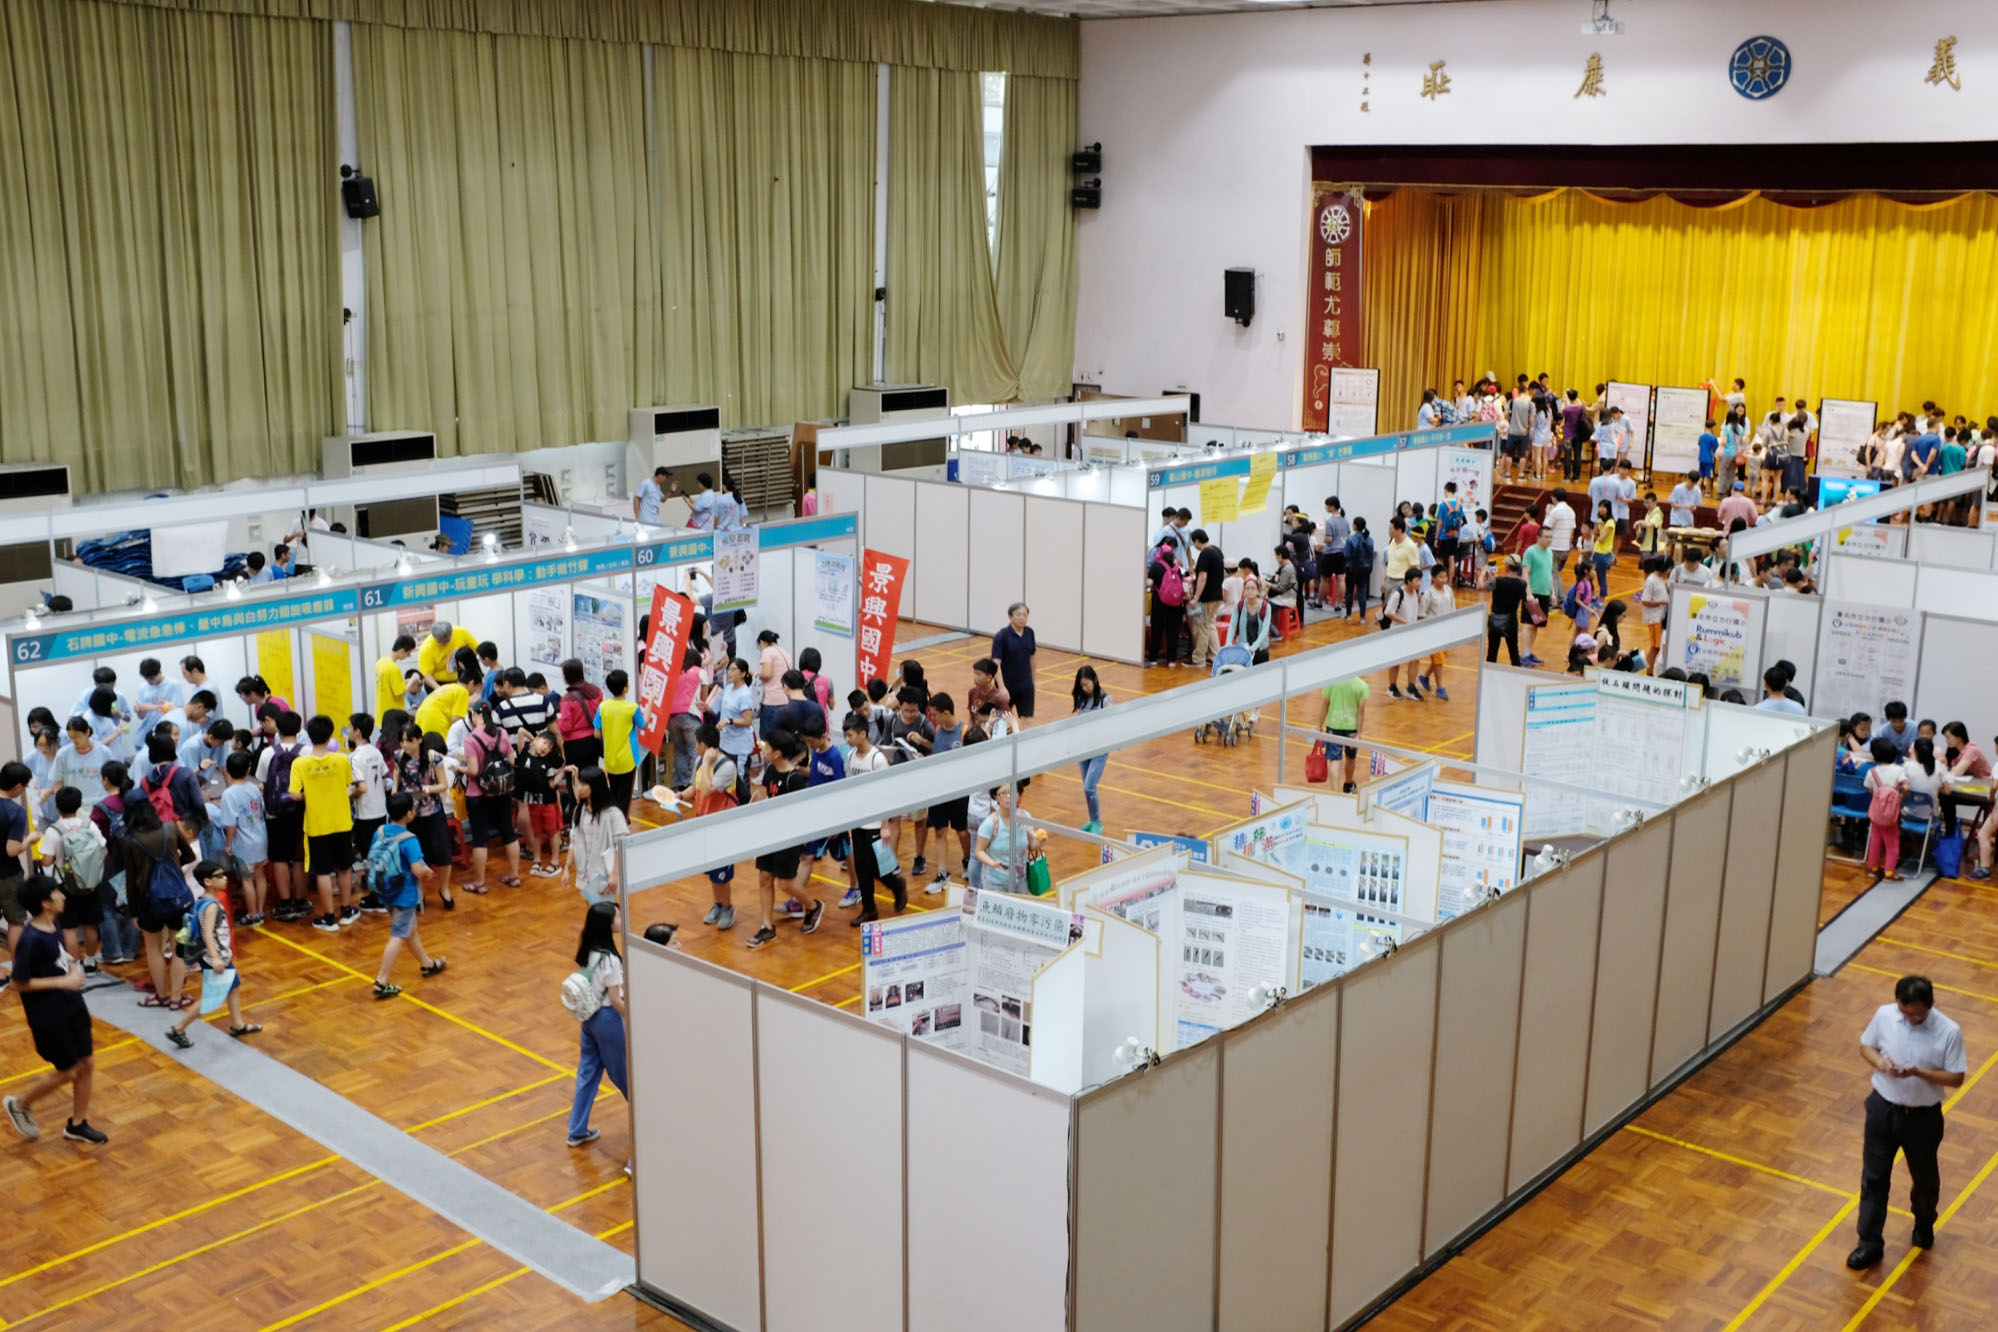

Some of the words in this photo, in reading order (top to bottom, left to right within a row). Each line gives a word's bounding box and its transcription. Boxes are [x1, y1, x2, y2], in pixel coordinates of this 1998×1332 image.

[1322, 248, 1342, 362] 師範尤尊崇
[1150, 473, 1160, 486] 59
[637, 548, 653, 564] 60
[669, 542, 712, 560] 景興國中-
[364, 589, 383, 606] 61
[860, 562, 895, 686] 景興國中
[1696, 624, 1742, 639] Rummikub
[17, 640, 41, 661] 62
